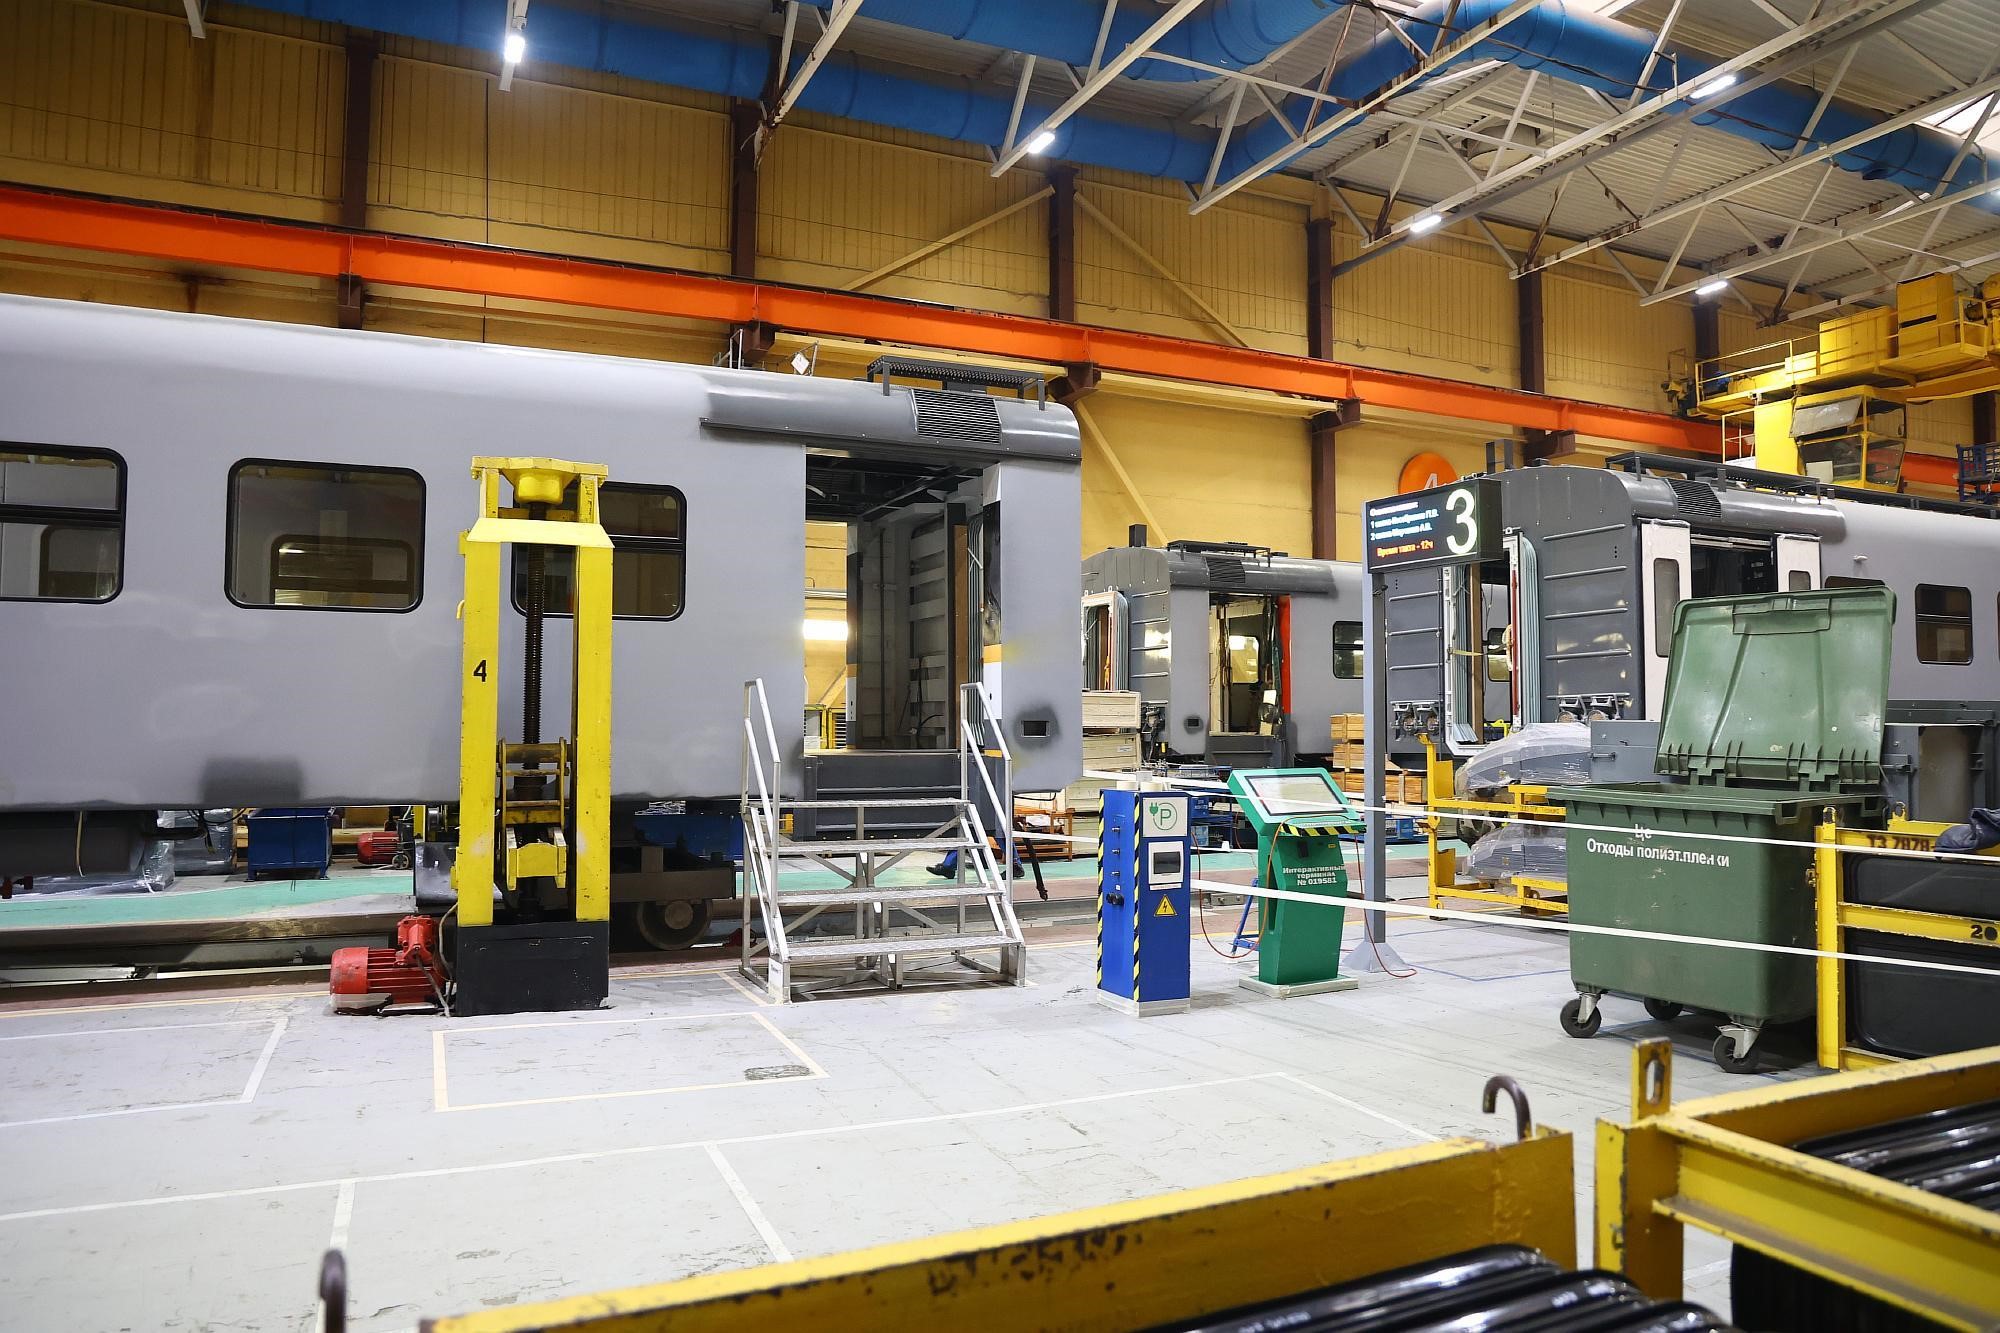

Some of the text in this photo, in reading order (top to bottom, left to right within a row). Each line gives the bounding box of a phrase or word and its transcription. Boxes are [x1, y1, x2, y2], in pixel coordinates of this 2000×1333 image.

[1446, 489, 1477, 554] 3
[473, 659, 487, 682] 4
[1586, 838, 1634, 858] Отходы
